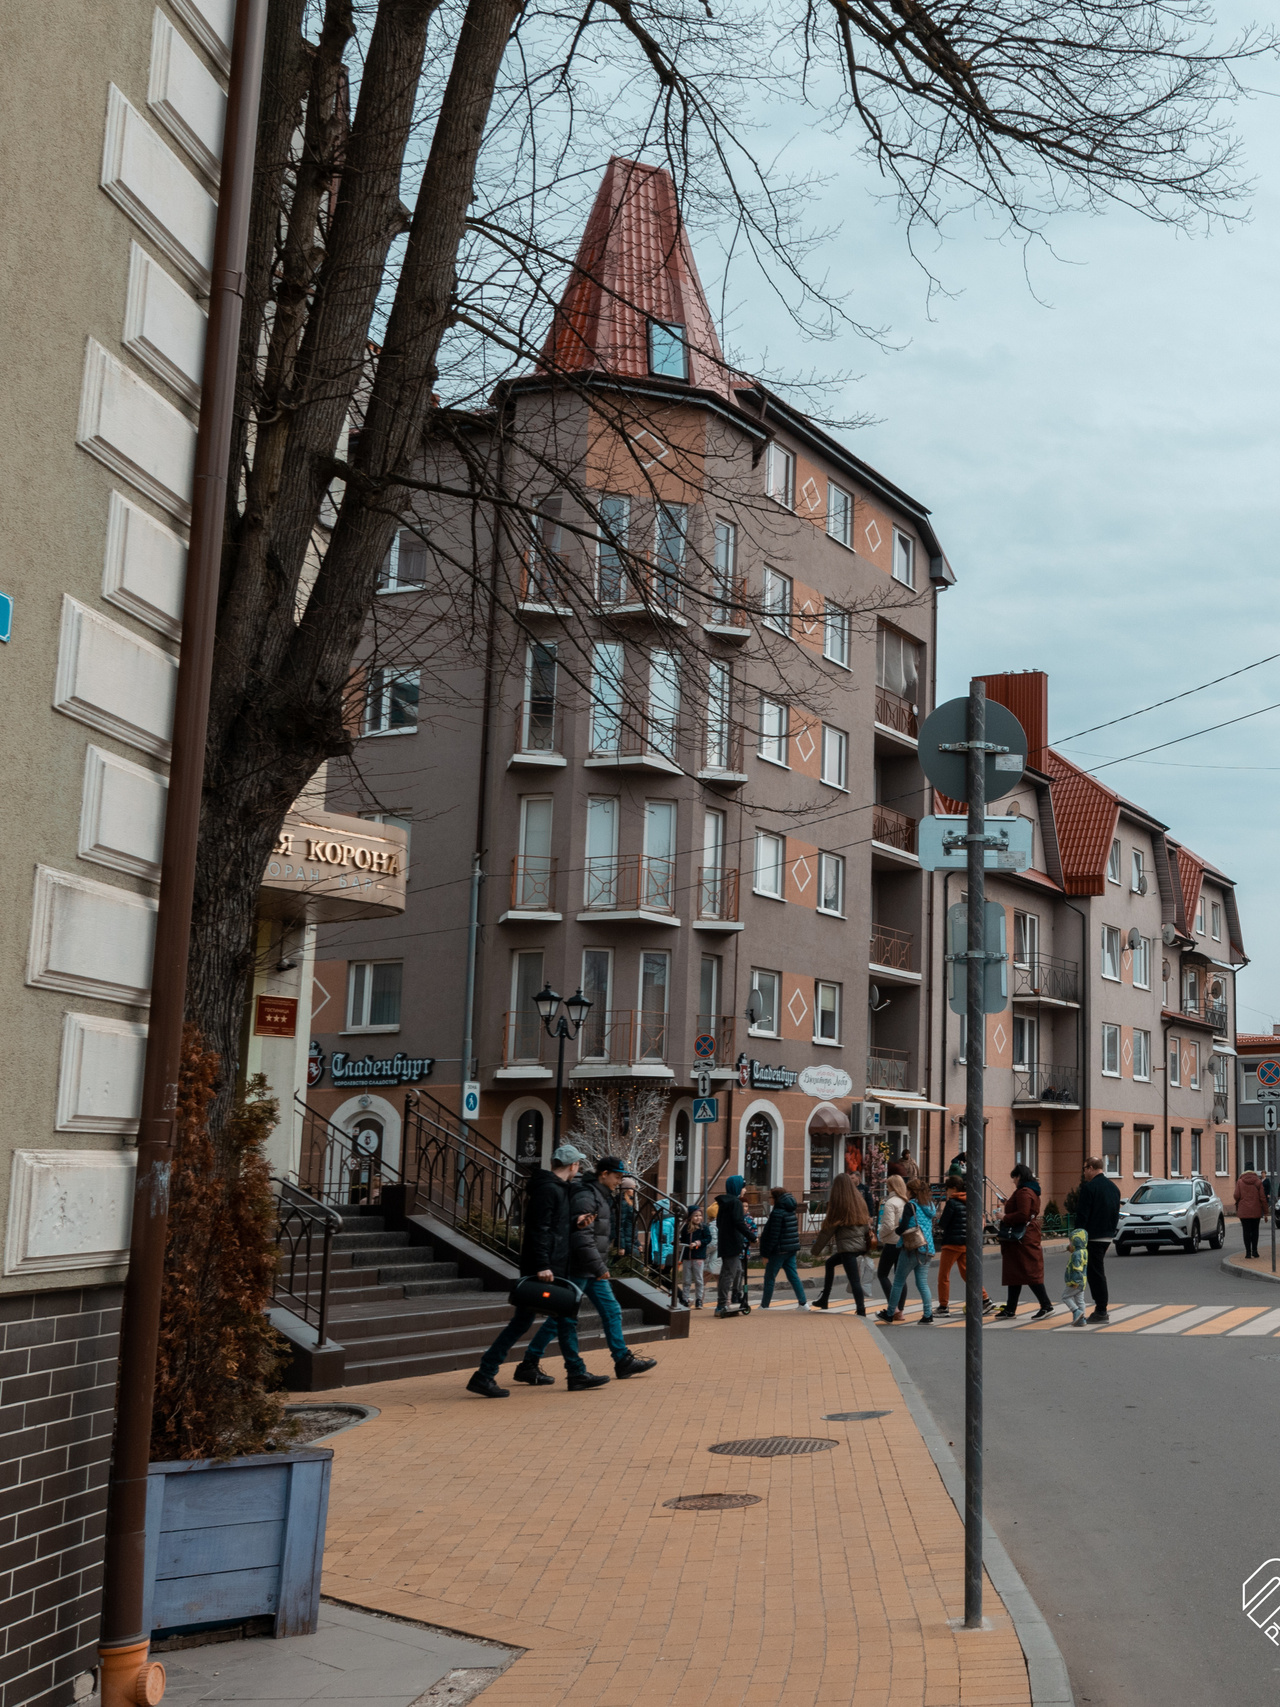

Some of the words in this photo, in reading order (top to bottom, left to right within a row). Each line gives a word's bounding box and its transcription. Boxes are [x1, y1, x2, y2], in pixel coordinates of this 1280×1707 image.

[272, 833, 295, 855] Я
[308, 838, 400, 876] КОРОНА
[268, 862, 320, 882] ОРАН
[339, 874, 373, 891] БАР
[331, 1053, 432, 1080] Сладенбург
